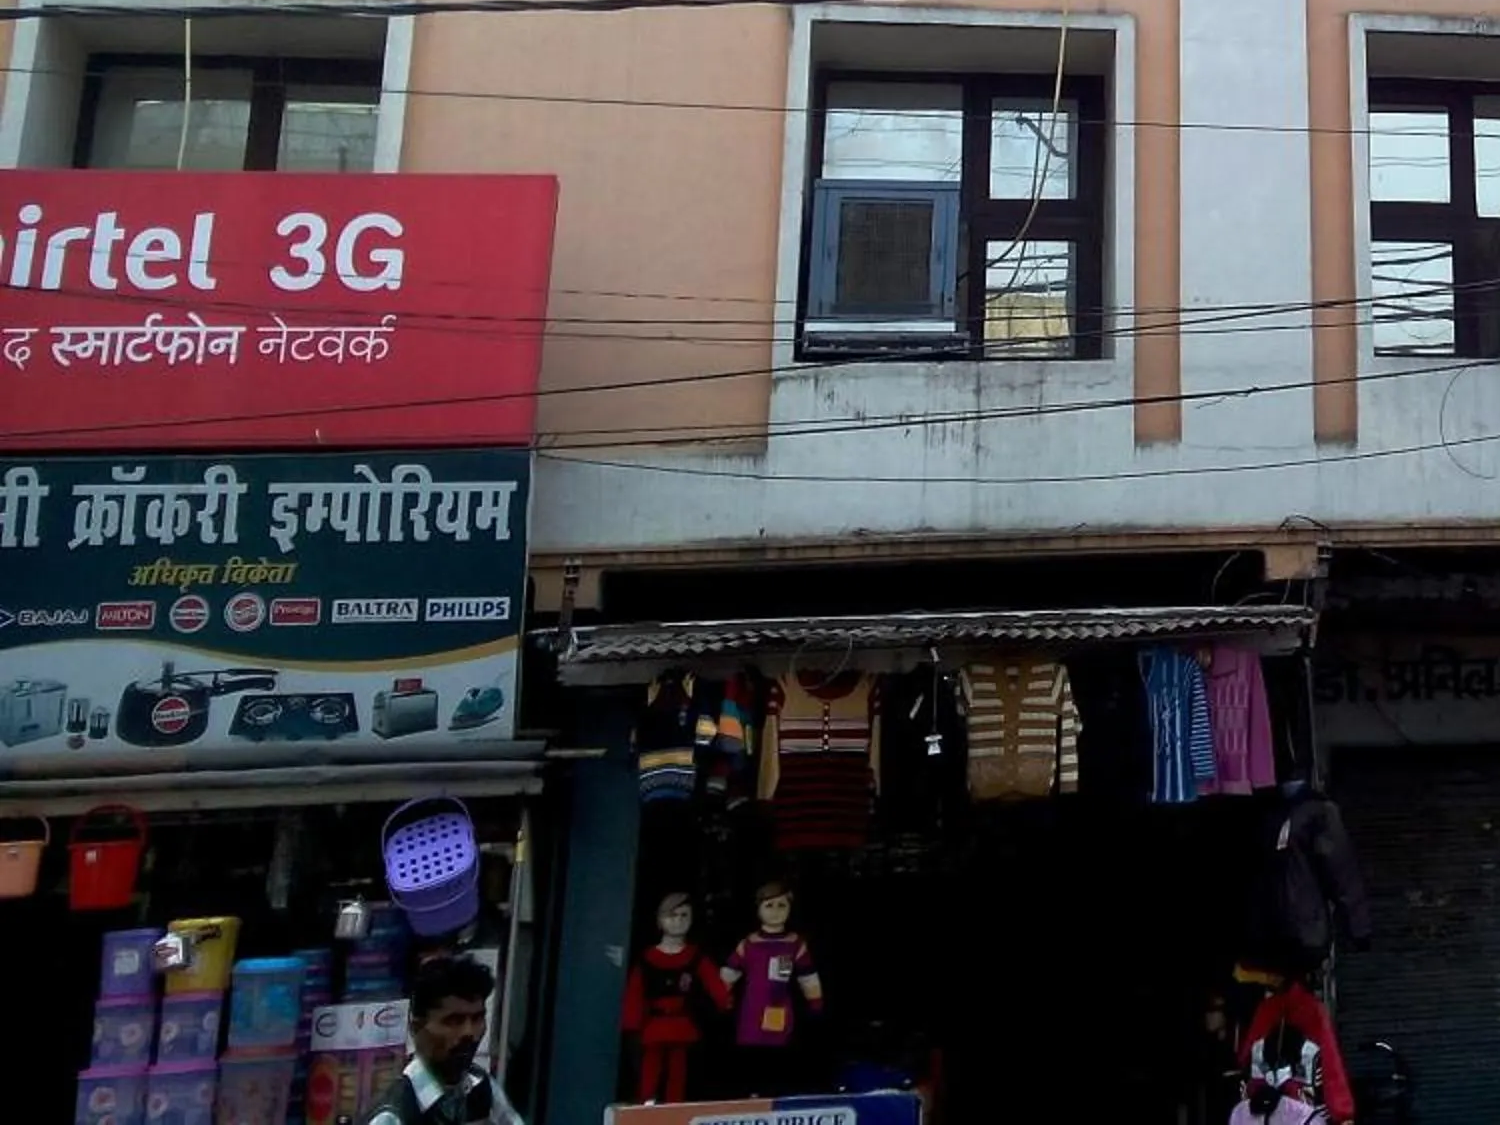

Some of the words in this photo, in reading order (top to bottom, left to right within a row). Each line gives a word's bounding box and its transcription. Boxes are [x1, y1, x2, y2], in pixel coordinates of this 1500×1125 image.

[0, 204, 218, 291] irtel
[269, 212, 404, 292] 3G
[3, 327, 39, 368] द
[50, 312, 247, 367] स्मार्टफोन
[257, 311, 397, 365] नेटवर्क
[67, 465, 248, 551] क्रॉकरी
[268, 464, 518, 553] इम्पोरियम
[17, 609, 89, 626] BAJAJ
[335, 601, 414, 617] BALTRA
[428, 599, 507, 619] PHILIPS
